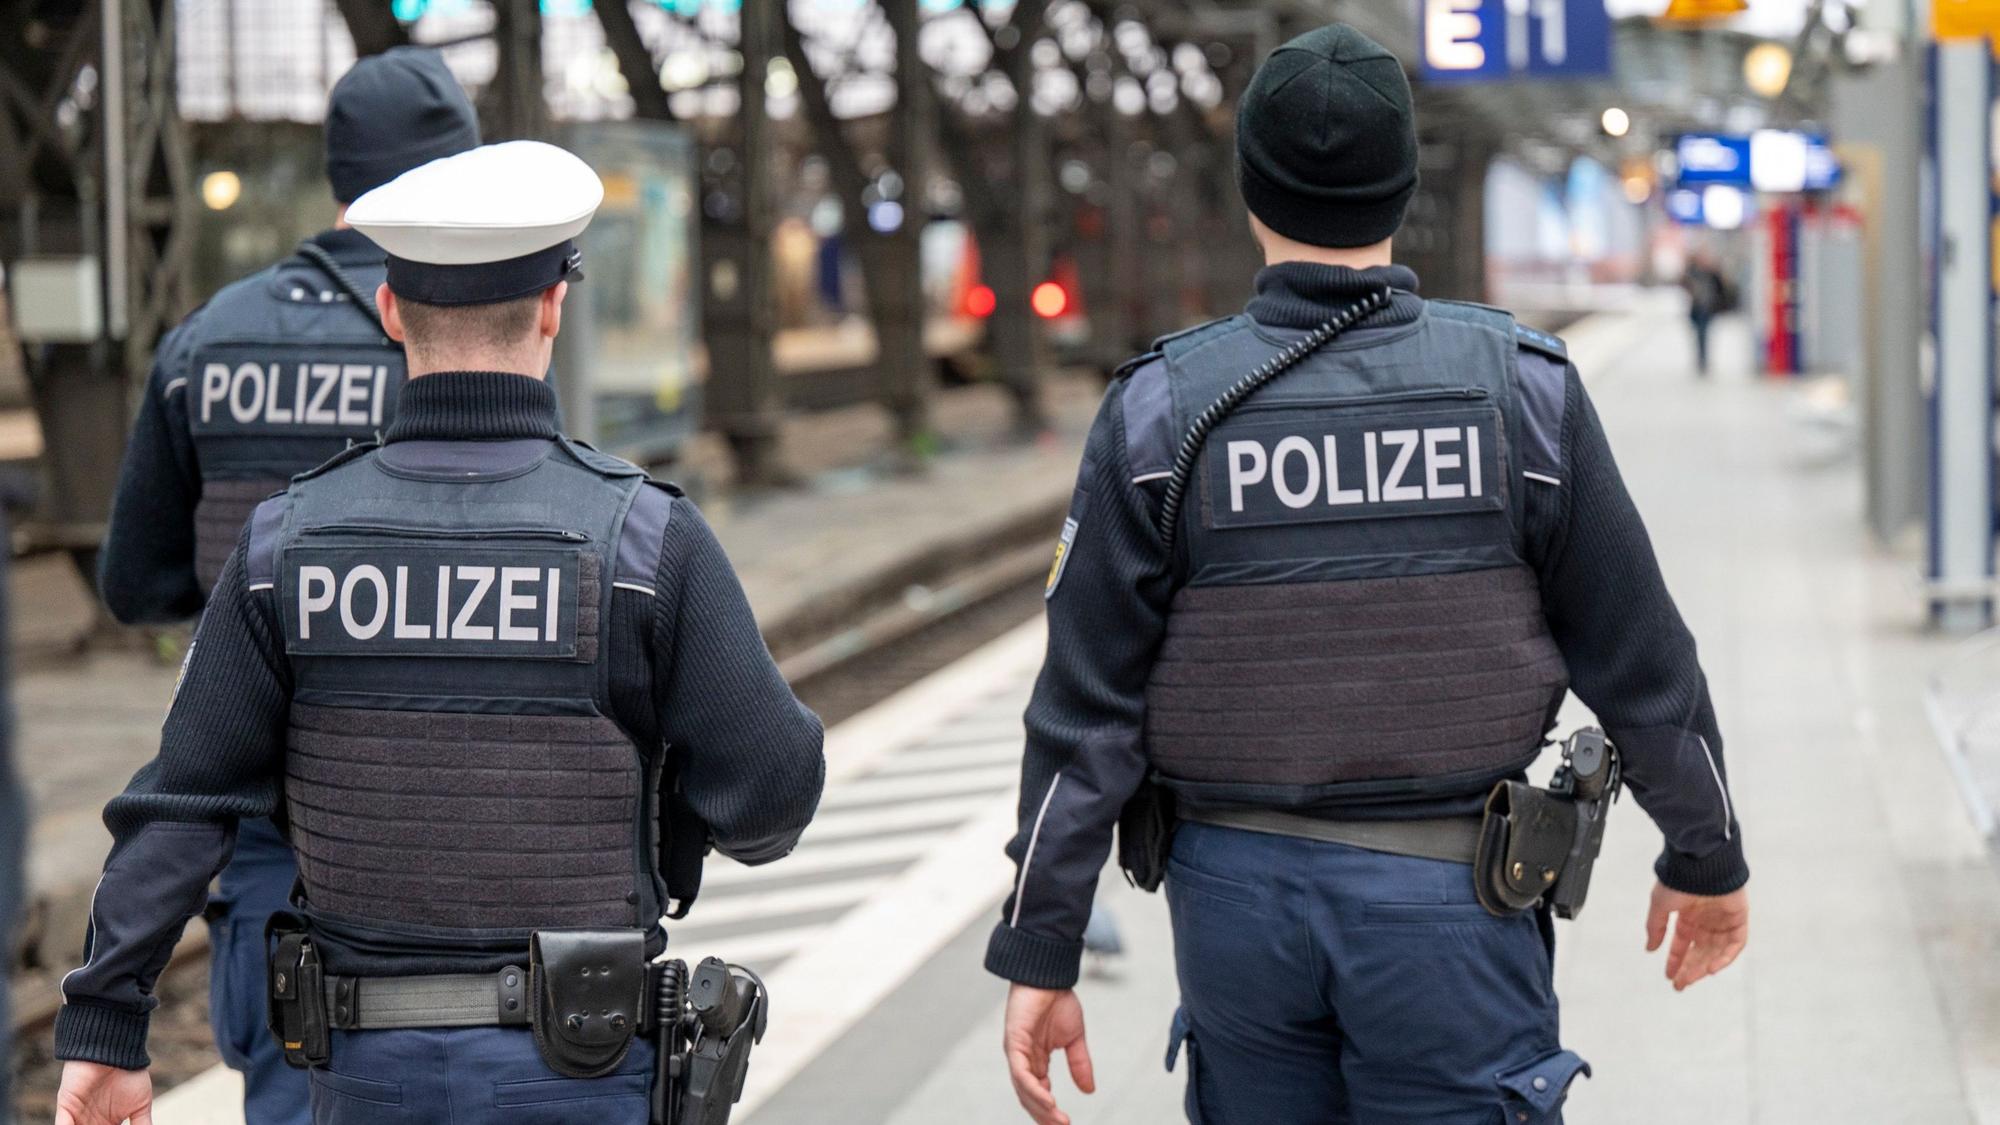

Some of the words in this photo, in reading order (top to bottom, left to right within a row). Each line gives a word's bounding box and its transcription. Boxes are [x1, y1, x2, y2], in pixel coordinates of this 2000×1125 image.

[202, 362, 388, 426] POLIZEI
[1227, 426, 1482, 512] POLIZEI
[299, 564, 560, 642] POLIZEI
